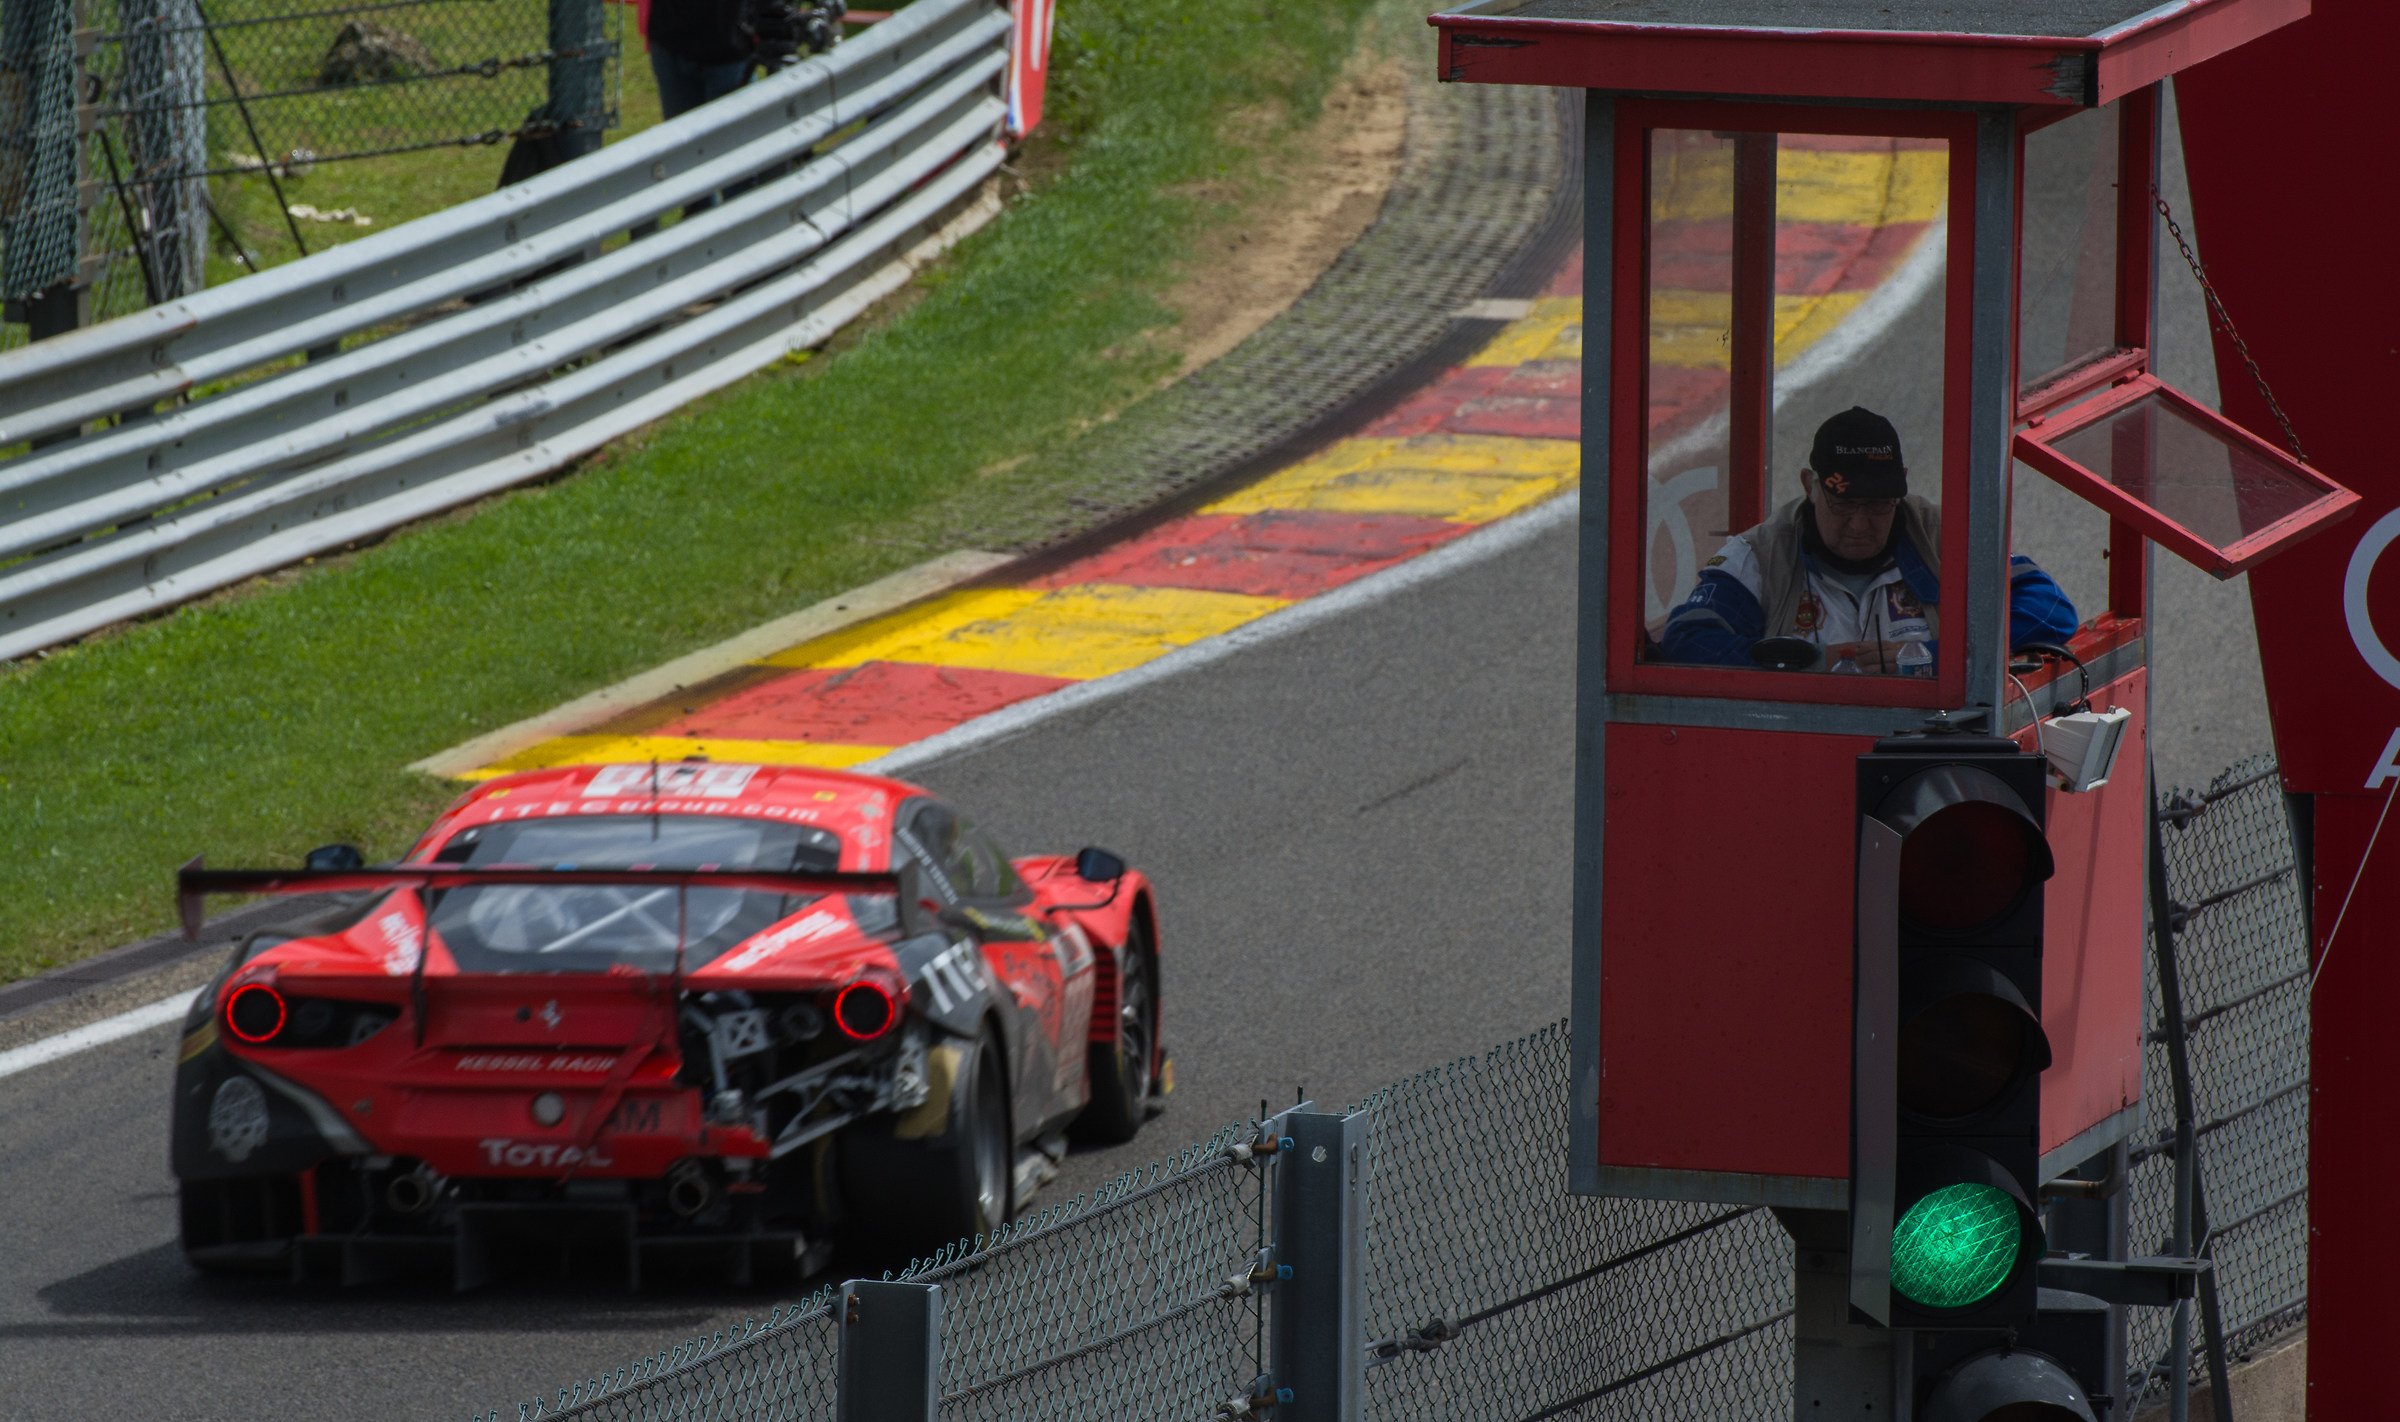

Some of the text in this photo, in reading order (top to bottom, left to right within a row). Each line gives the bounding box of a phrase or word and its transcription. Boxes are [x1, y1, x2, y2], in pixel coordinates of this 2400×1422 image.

[1835, 445, 1893, 455] BLANCPAIN
[1824, 472, 1851, 494] 24
[455, 1056, 545, 1071] KESSEL
[479, 1139, 614, 1168] TOTAL
